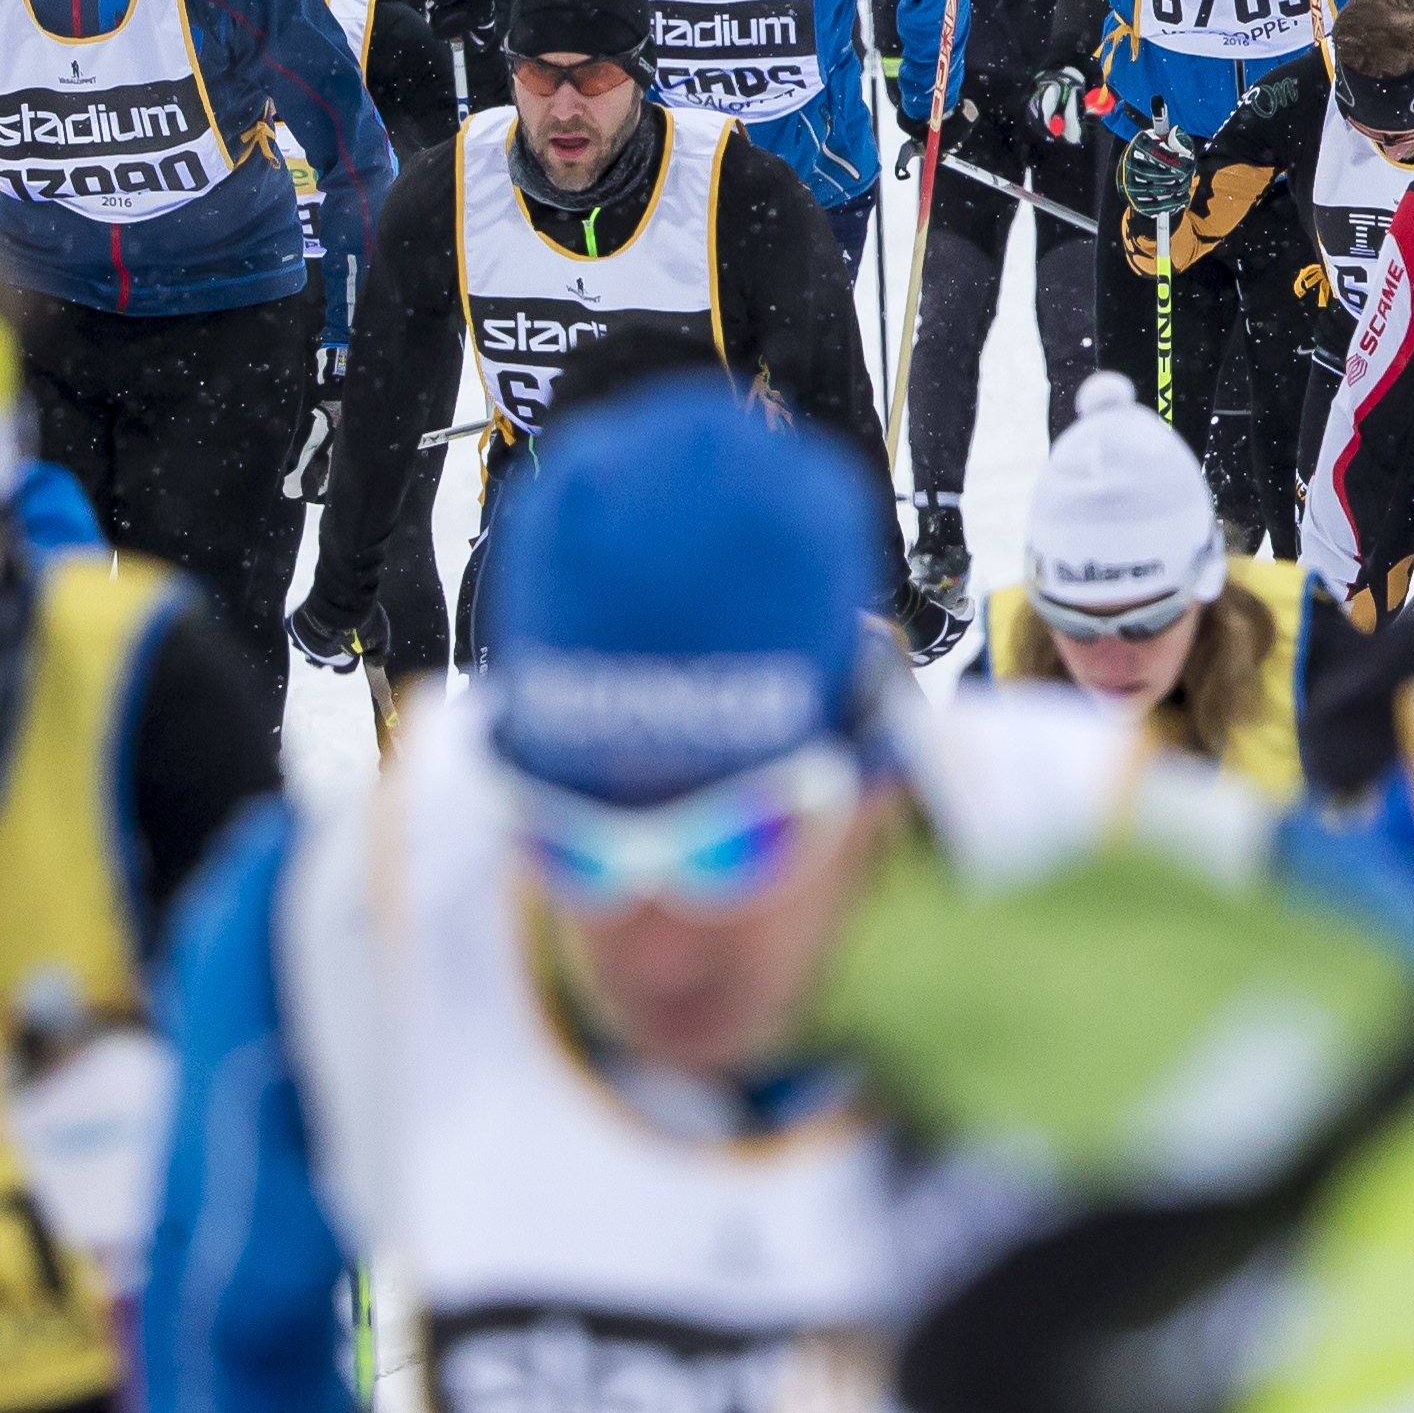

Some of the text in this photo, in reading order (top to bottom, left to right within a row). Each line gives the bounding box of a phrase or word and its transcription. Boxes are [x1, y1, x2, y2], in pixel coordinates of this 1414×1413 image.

[651, 10, 797, 48] tadium
[101, 196, 132, 209] 2016
[1359, 259, 1405, 357] SCAME
